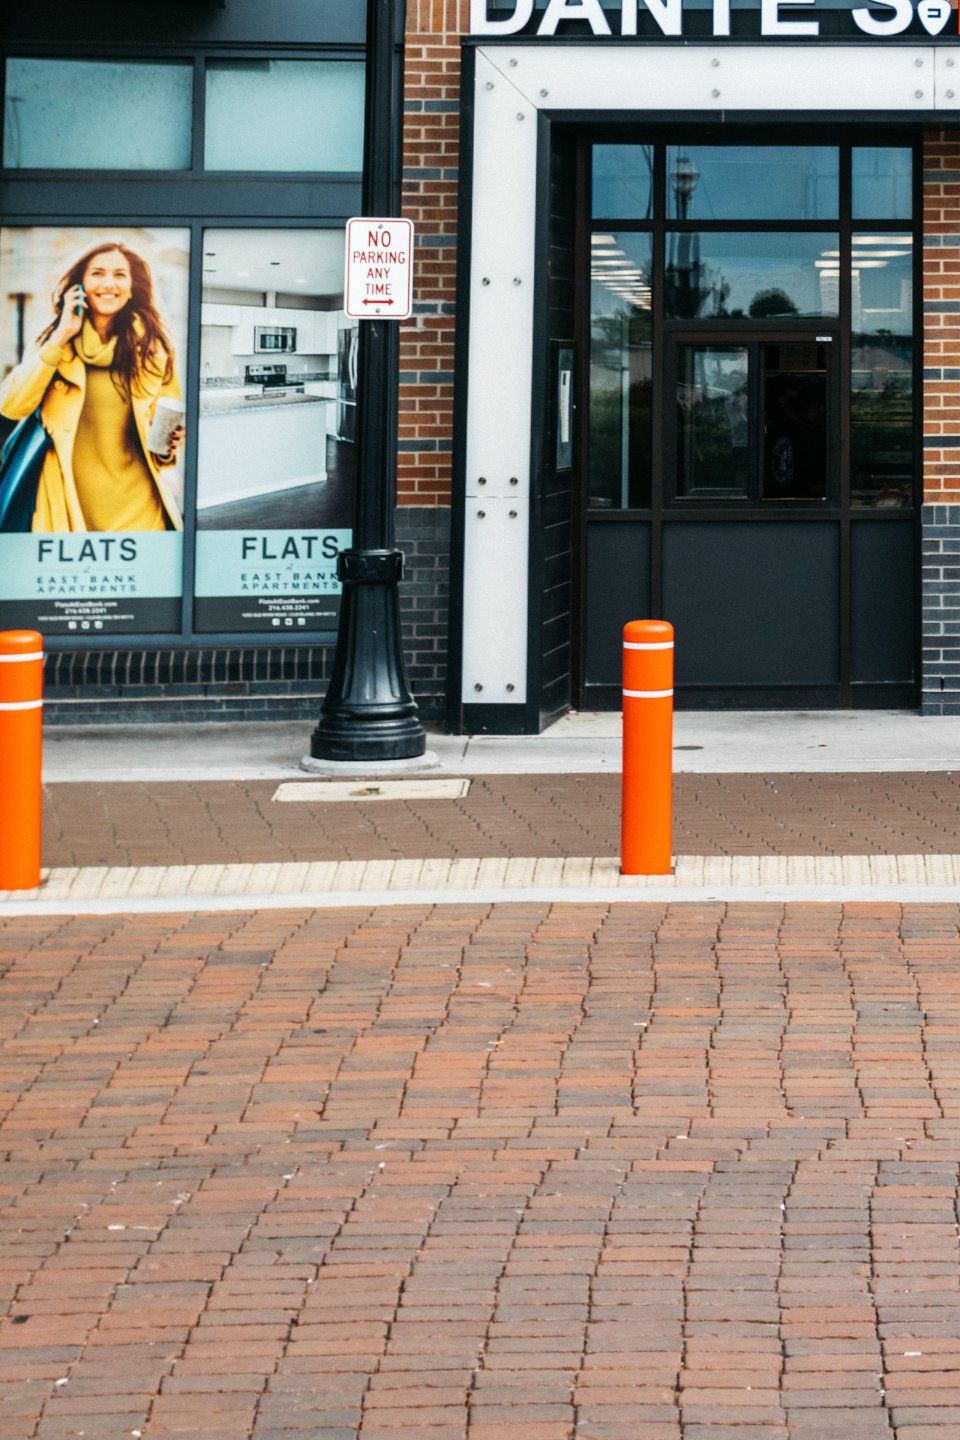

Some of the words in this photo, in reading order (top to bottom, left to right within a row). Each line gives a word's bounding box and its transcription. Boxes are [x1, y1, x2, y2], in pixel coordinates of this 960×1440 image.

[368, 230, 391, 247] NO
[353, 250, 406, 264] PARKING
[366, 267, 390, 279] ANY
[365, 283, 392, 295] TIME
[37, 538, 137, 562] FLATS
[242, 535, 339, 559] FLATS
[37, 575, 79, 584] EAST
[90, 574, 136, 583] BANK
[241, 572, 282, 581] EAST
[293, 572, 338, 580] BANK
[37, 583, 136, 593] APARTMENTS
[241, 581, 339, 590] APARTMENTS
